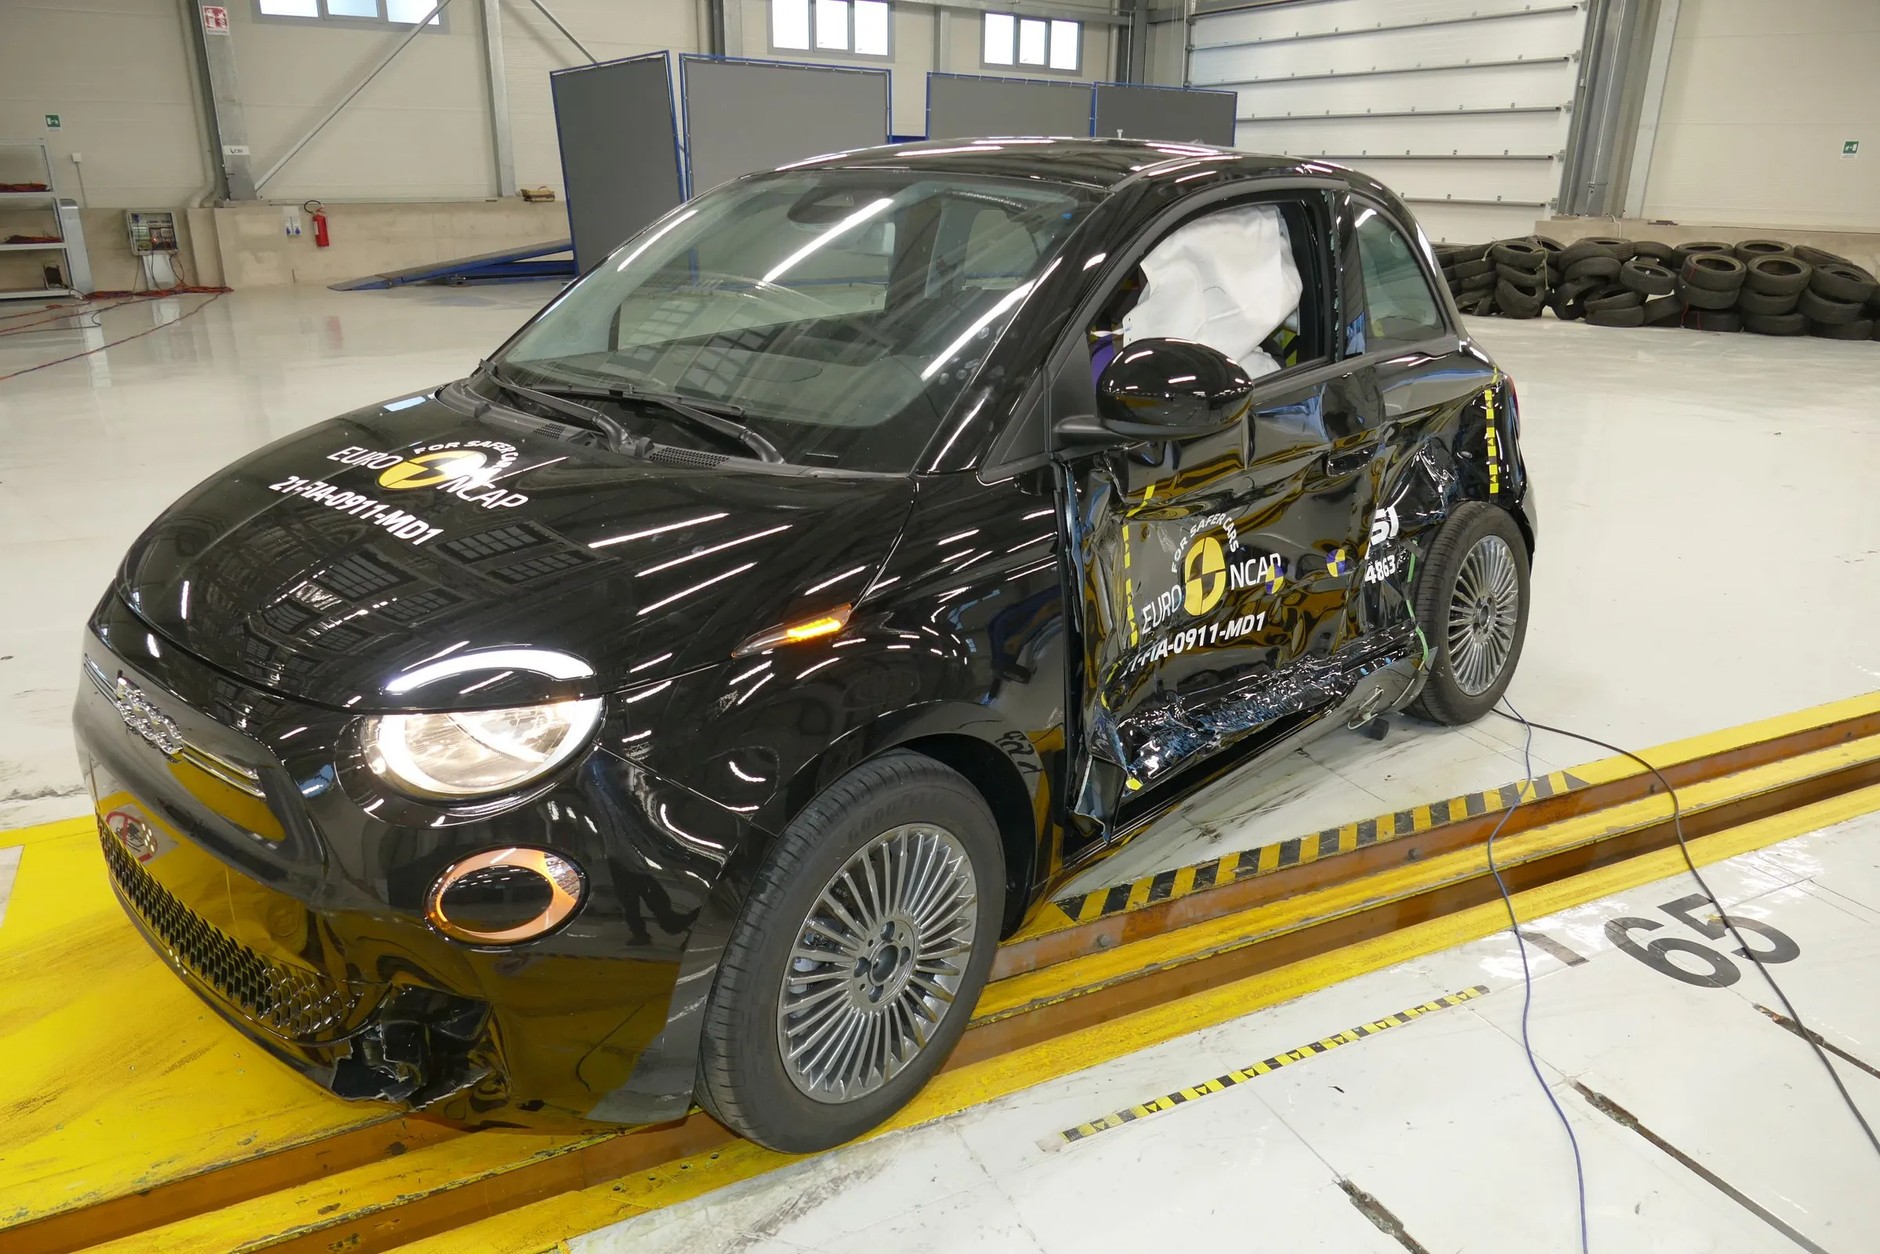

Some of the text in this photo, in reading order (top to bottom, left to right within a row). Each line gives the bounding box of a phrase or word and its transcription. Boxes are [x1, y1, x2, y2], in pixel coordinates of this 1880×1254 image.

[413, 441, 460, 455] FOR
[326, 445, 529, 510] EURO NCAP
[268, 475, 445, 546] 21-FIA-0911-MD1
[1171, 512, 1240, 574] FOR SAFER CARS
[1364, 554, 1396, 584] 4863
[1141, 584, 1182, 636] EURO
